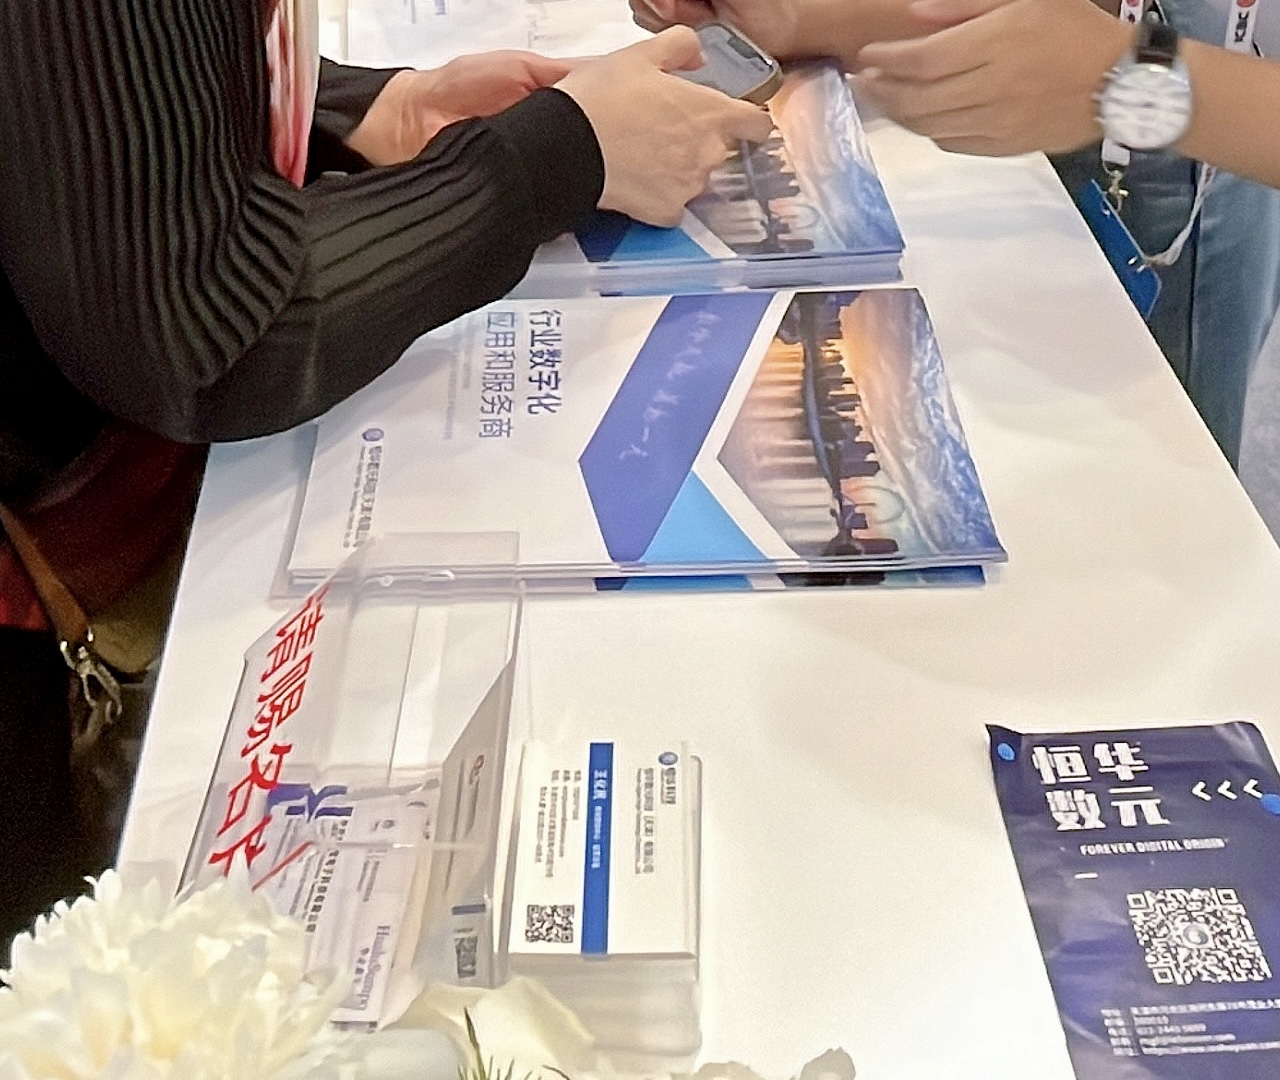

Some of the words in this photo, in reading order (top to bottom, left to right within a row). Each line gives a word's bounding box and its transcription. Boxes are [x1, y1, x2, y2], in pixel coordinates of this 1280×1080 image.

[478, 311, 516, 438] 应用和服务商
[526, 308, 563, 415] 行业数字化
[208, 582, 330, 878] 请赐名片
[1031, 741, 1150, 786] 恒华
[1044, 786, 1172, 832] 数元
[1079, 840, 1135, 856] FOREVER
